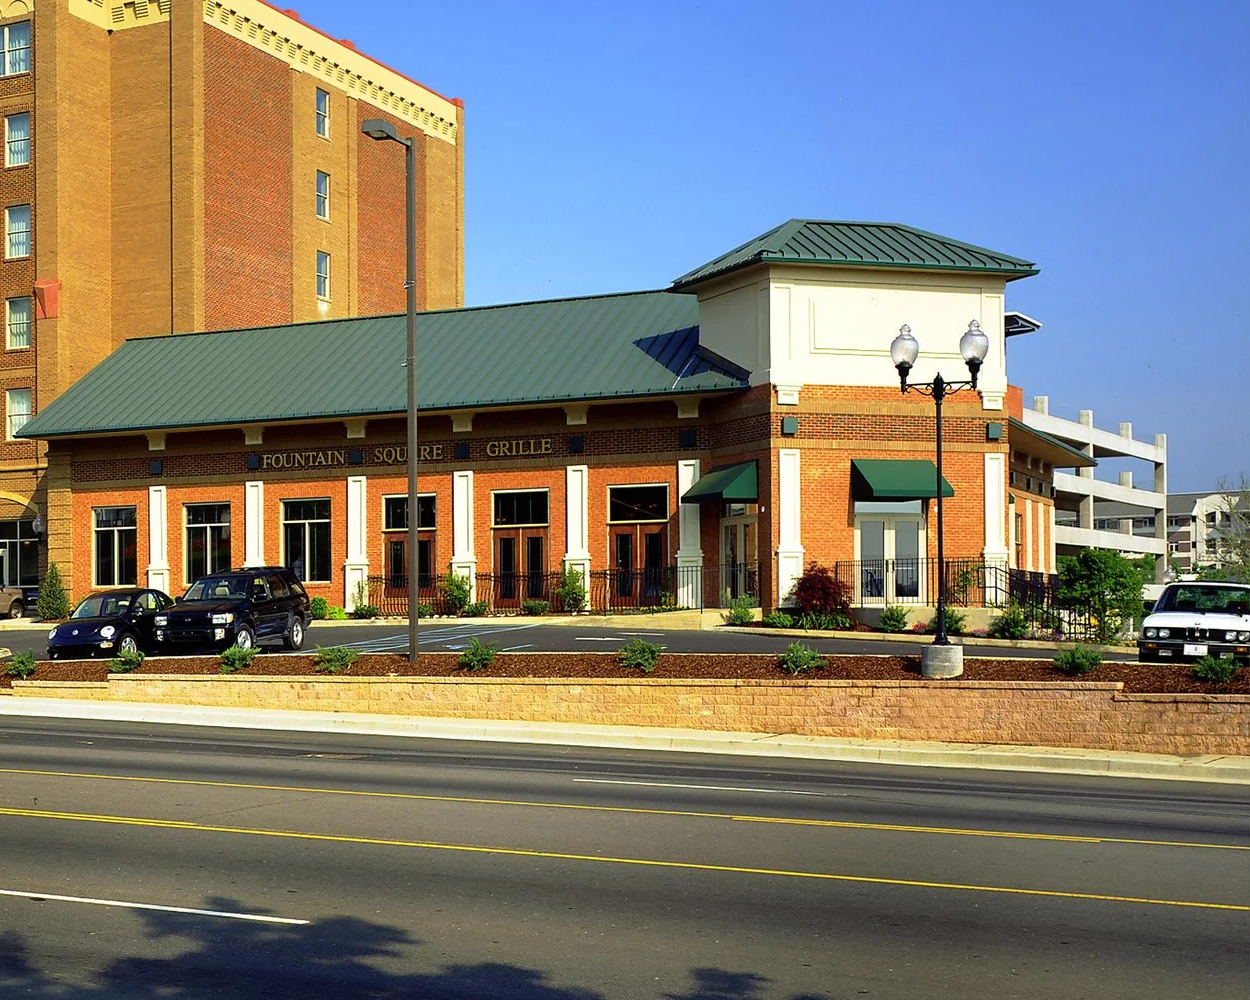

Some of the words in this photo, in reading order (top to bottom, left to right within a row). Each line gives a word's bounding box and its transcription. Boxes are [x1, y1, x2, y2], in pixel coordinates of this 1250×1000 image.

[261, 450, 346, 469] FOUNTAIN
[374, 445, 444, 464] SQURE
[486, 438, 553, 457] GRILLE
